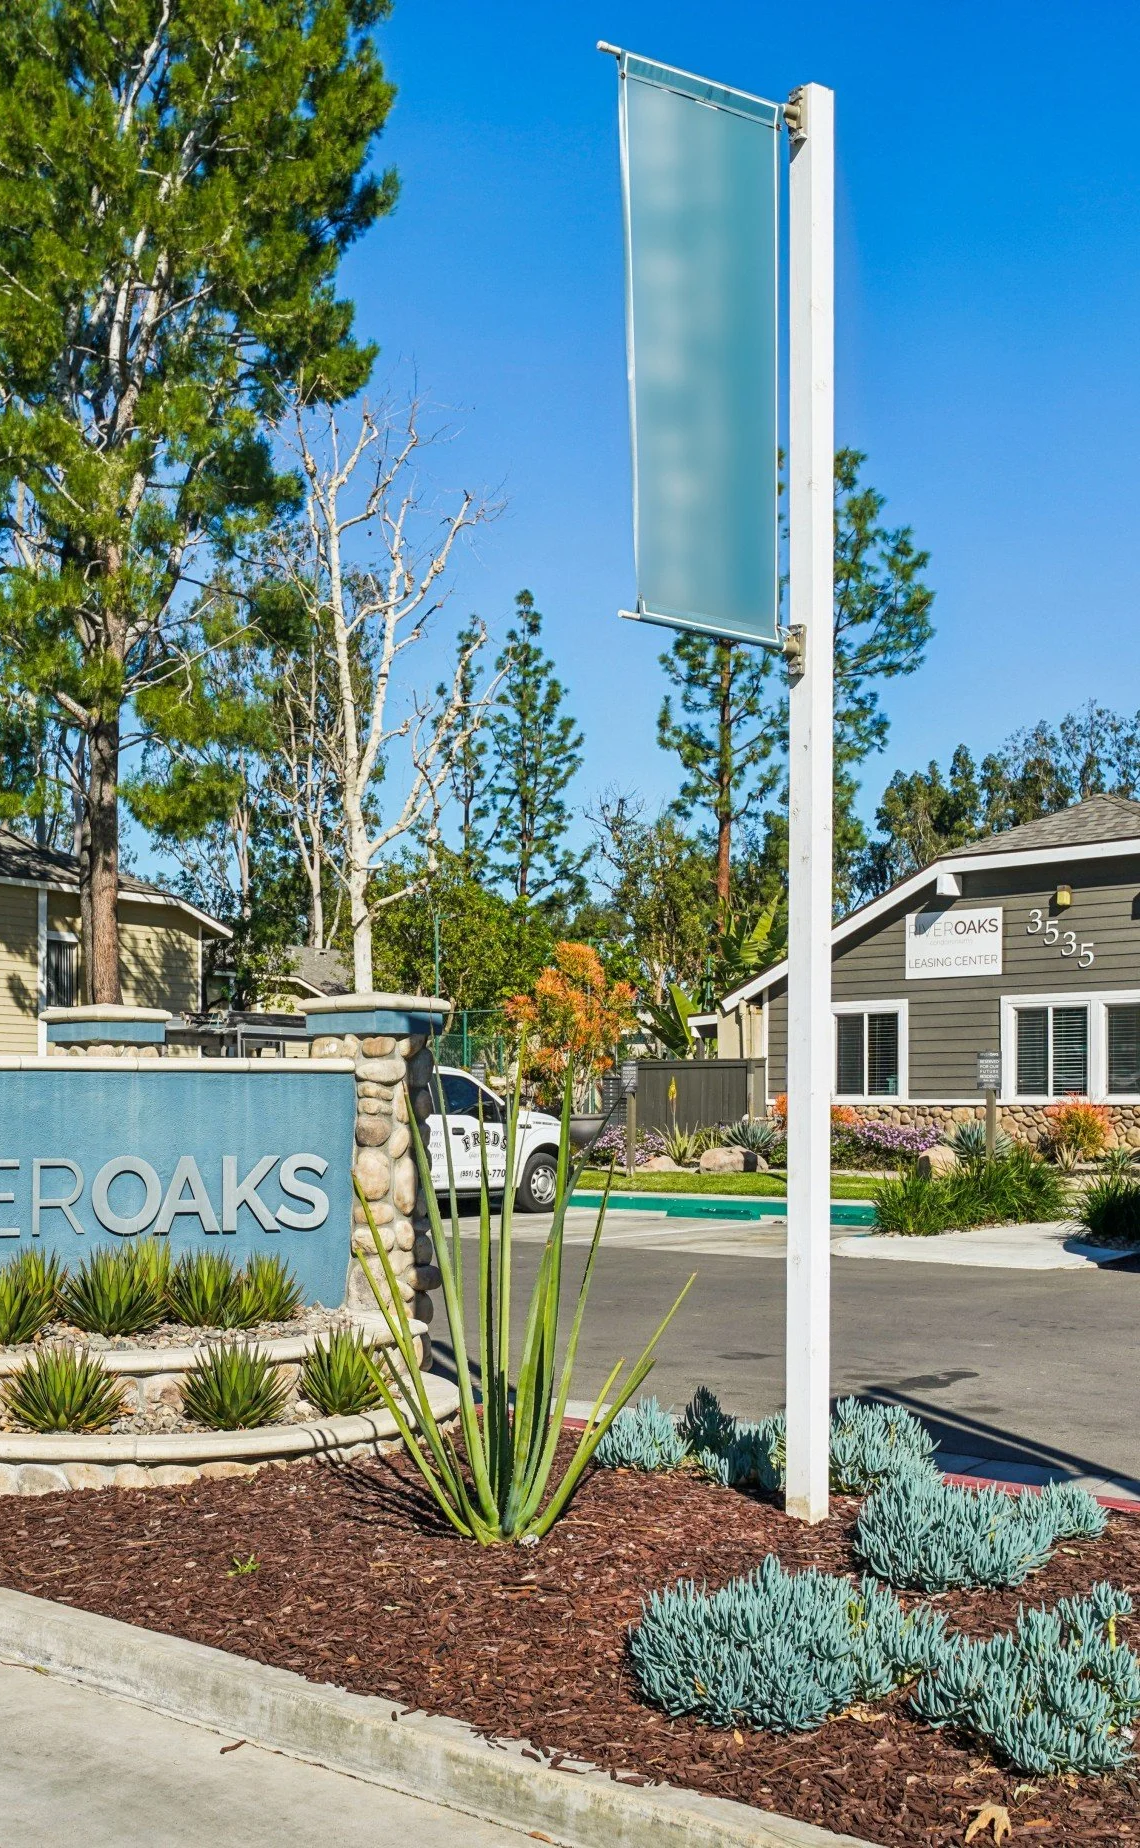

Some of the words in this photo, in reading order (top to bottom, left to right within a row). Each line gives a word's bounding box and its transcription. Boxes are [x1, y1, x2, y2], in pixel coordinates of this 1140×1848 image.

[908, 918, 999, 939] RIVEROAKS
[1026, 908, 1095, 968] 3535
[908, 957, 952, 969] LEASING
[954, 954, 998, 966] CENTER
[461, 1130, 508, 1152] FREDS
[460, 1170, 474, 1178] (951)
